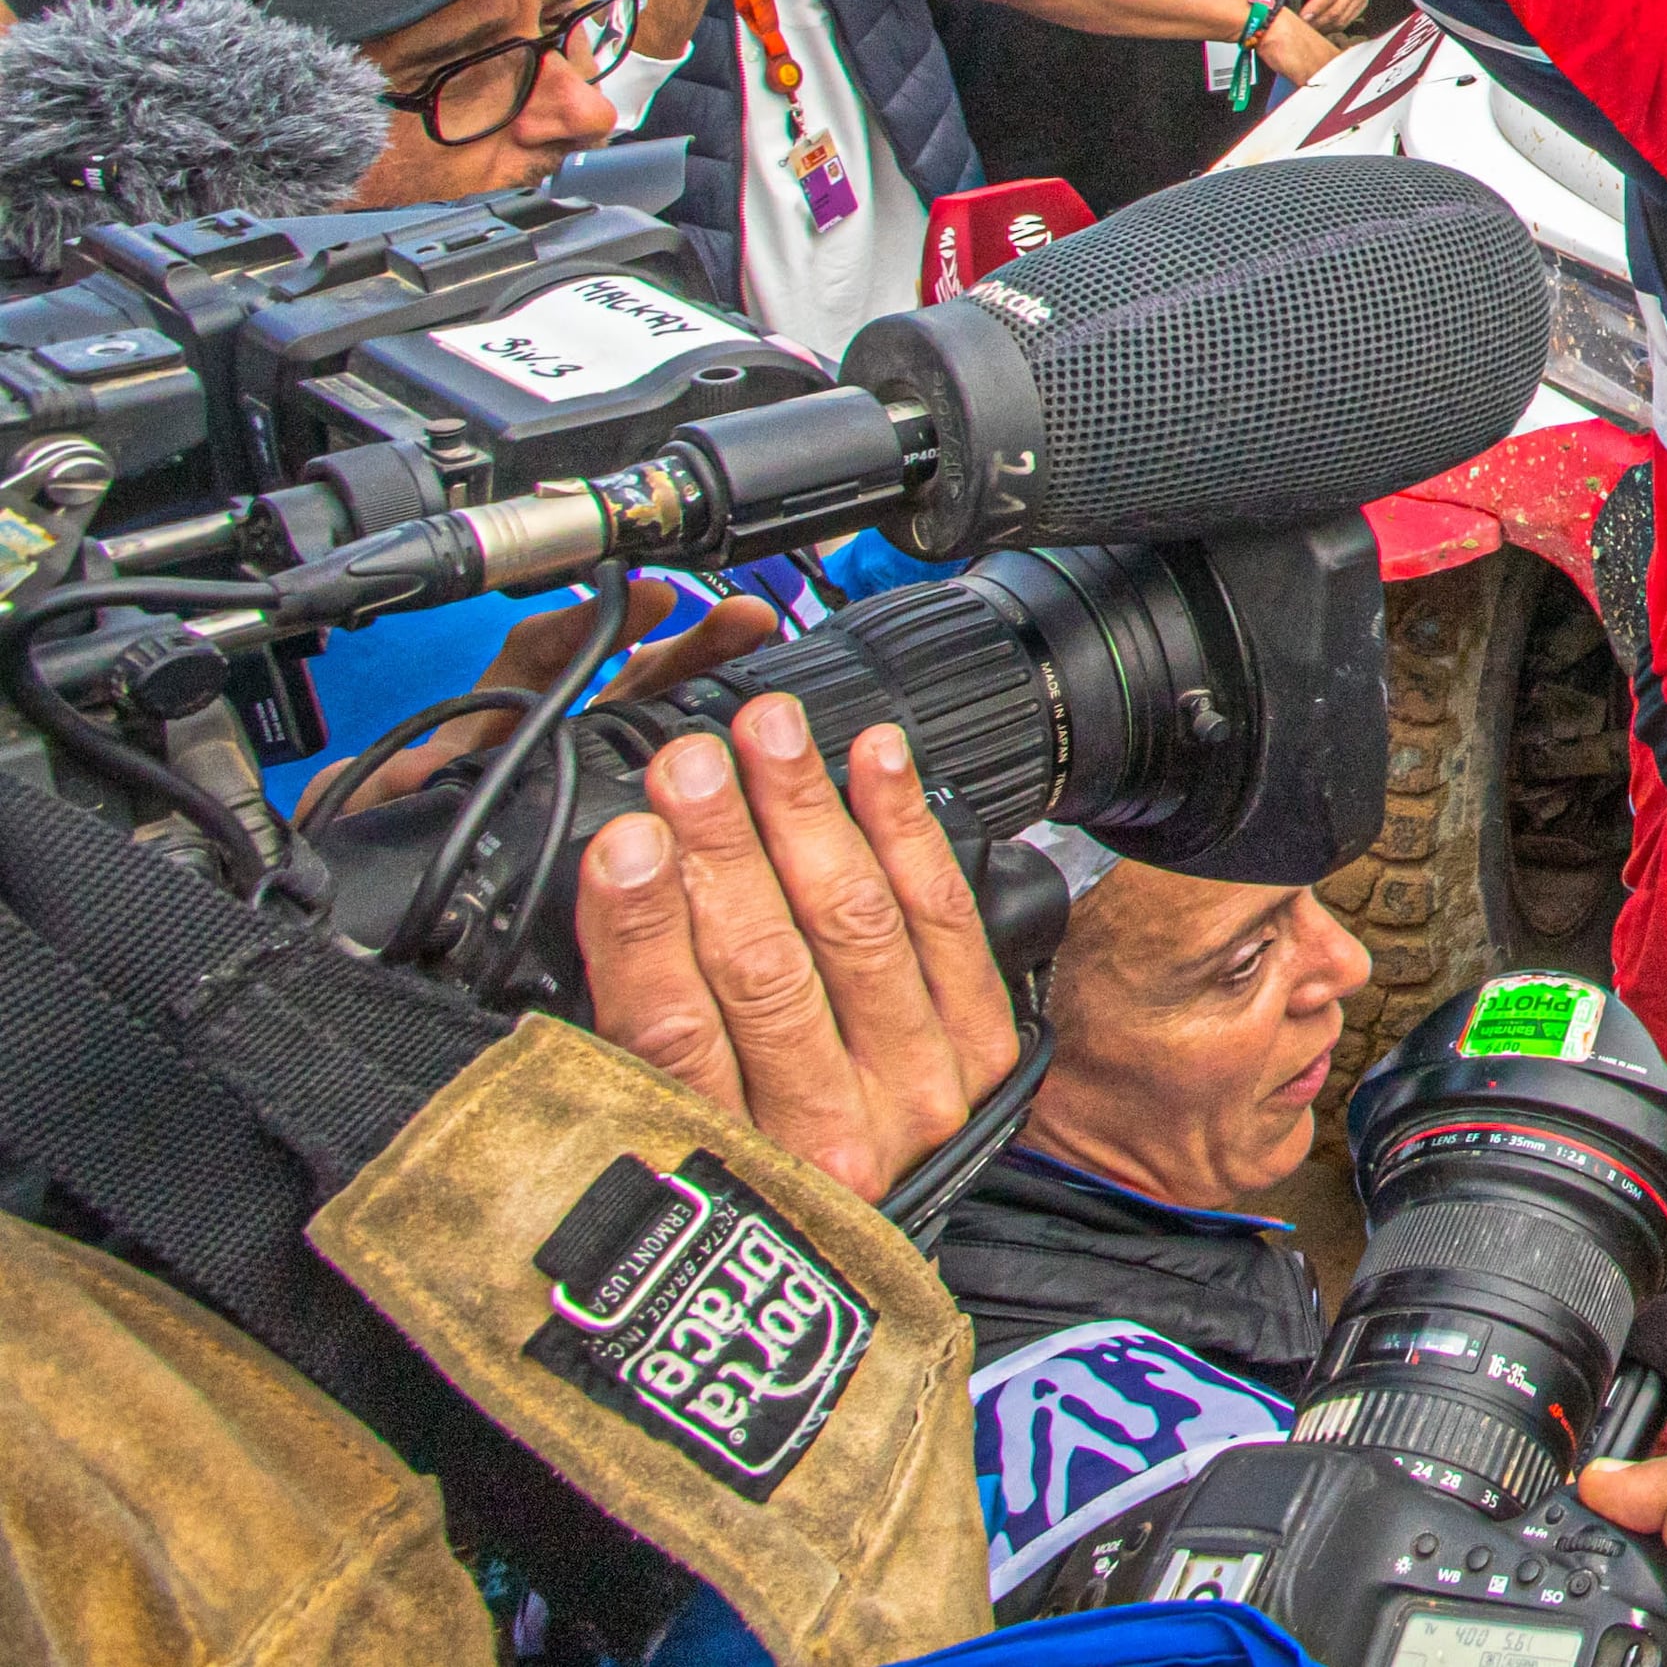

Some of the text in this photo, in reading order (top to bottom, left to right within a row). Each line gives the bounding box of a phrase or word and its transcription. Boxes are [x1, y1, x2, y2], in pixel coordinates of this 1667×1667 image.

[572, 276, 704, 341] MACKAY
[1490, 1014, 1546, 1026] Bahrain
[1430, 1133, 1458, 1148] LENS
[1464, 1133, 1482, 1144] EF
[1621, 1177, 1644, 1201] USM
[638, 1227, 788, 1399] brace
[684, 1260, 828, 1430] porta
[1409, 1460, 1501, 1509] 24 28 35
[1091, 1538, 1125, 1559] MODE
[1436, 1567, 1462, 1584] WB
[1539, 1588, 1565, 1605] ISO
